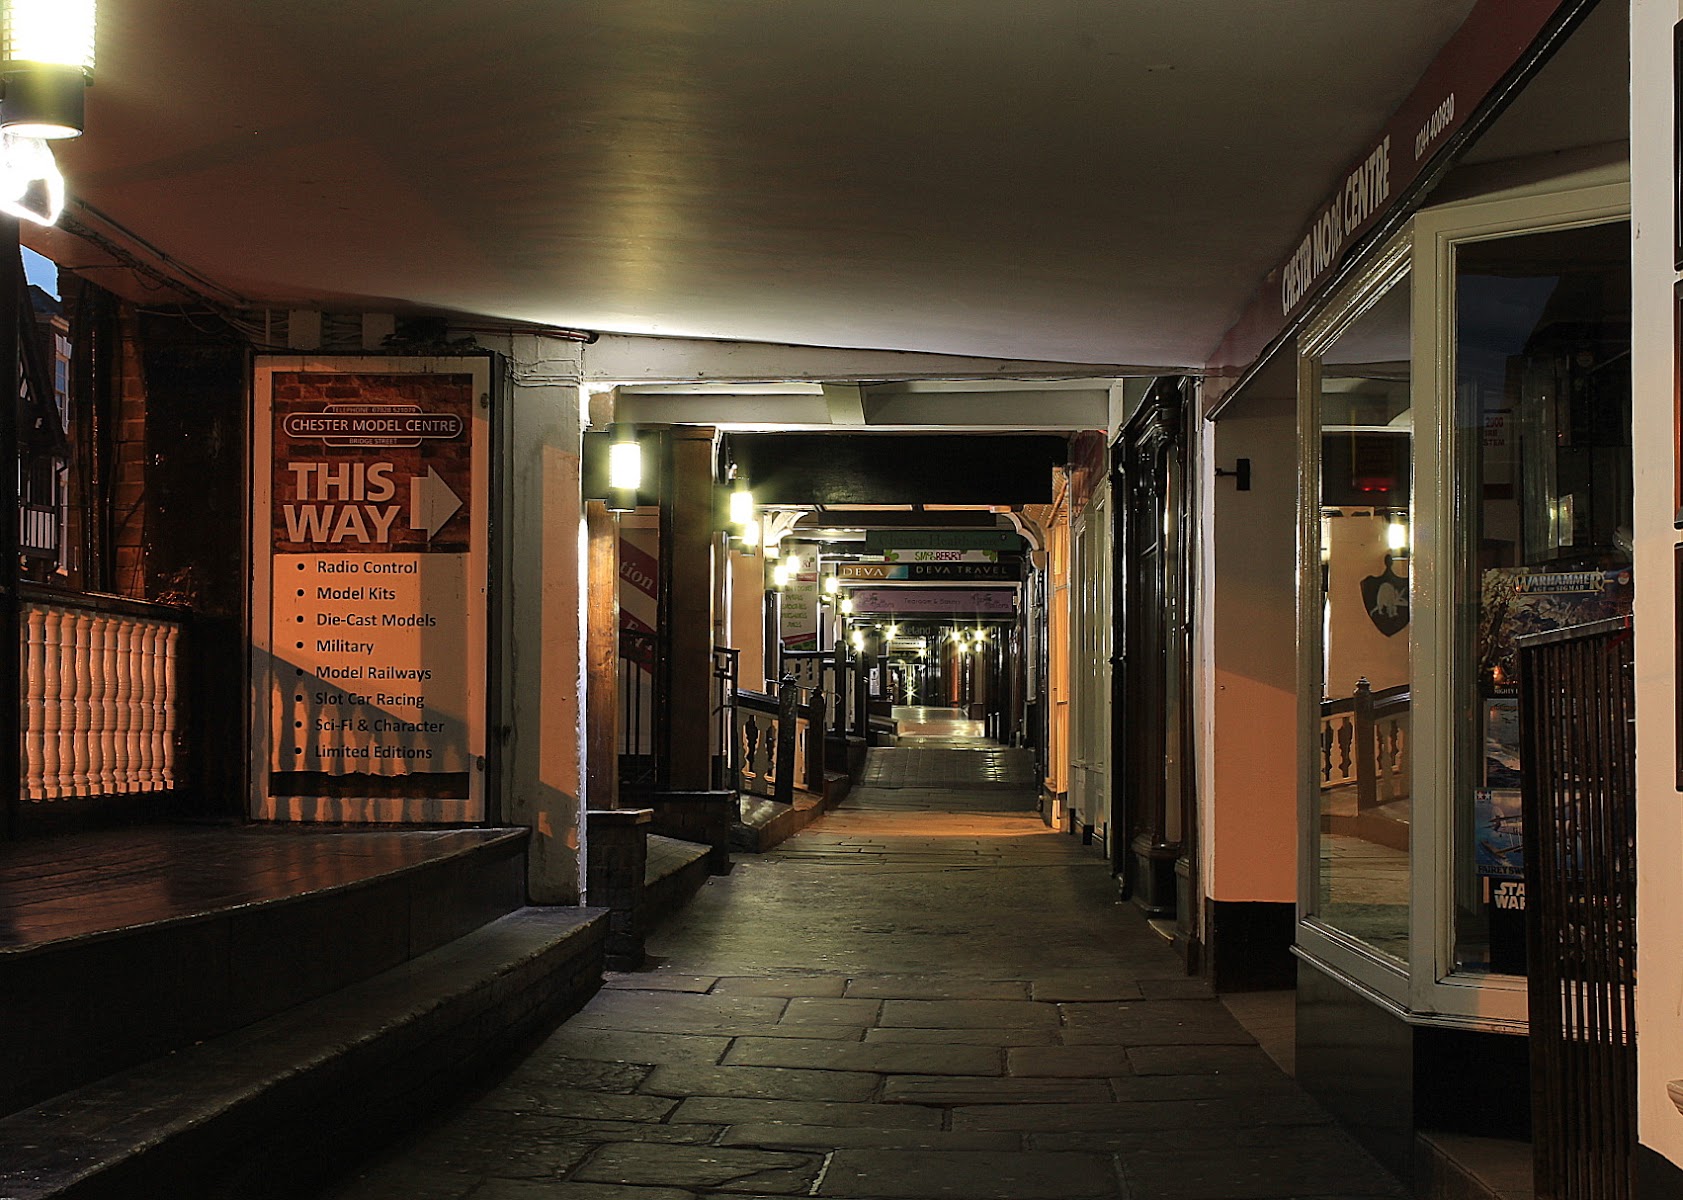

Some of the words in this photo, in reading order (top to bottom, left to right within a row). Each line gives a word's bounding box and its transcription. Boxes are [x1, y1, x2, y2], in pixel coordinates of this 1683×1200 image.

[1430, 92, 1455, 141] 400930
[1282, 233, 1312, 317] CHESTER
[1313, 190, 1343, 279] MODEL
[1344, 134, 1390, 237] CENTRE
[290, 419, 349, 431] CHESTER
[352, 419, 402, 432] MODEL
[405, 420, 457, 432] CENTRE
[288, 462, 396, 502] THIS
[283, 504, 401, 544] WAY
[317, 560, 360, 574] Radio
[363, 560, 418, 574] Control
[842, 566, 883, 577] DEVA
[916, 564, 951, 575] DEVA
[956, 564, 1009, 575] TRAVEL
[1516, 573, 1600, 592] WARHAMMER
[317, 587, 365, 600] Model
[368, 587, 396, 601] Kits
[316, 613, 378, 627] Die-Cast
[381, 614, 437, 627] Models
[316, 639, 375, 655] Military
[315, 666, 364, 679] Model
[367, 666, 432, 683] Railways
[315, 692, 344, 706] Slot
[347, 692, 371, 706] Car
[376, 692, 425, 709] Racing
[314, 718, 353, 732] Sci-Fi
[357, 719, 369, 732] &
[374, 718, 445, 733] Character
[314, 745, 369, 759] Limited
[373, 745, 433, 760] Editions
[1478, 865, 1508, 875] FAIREY
[1494, 882, 1525, 897] STA
